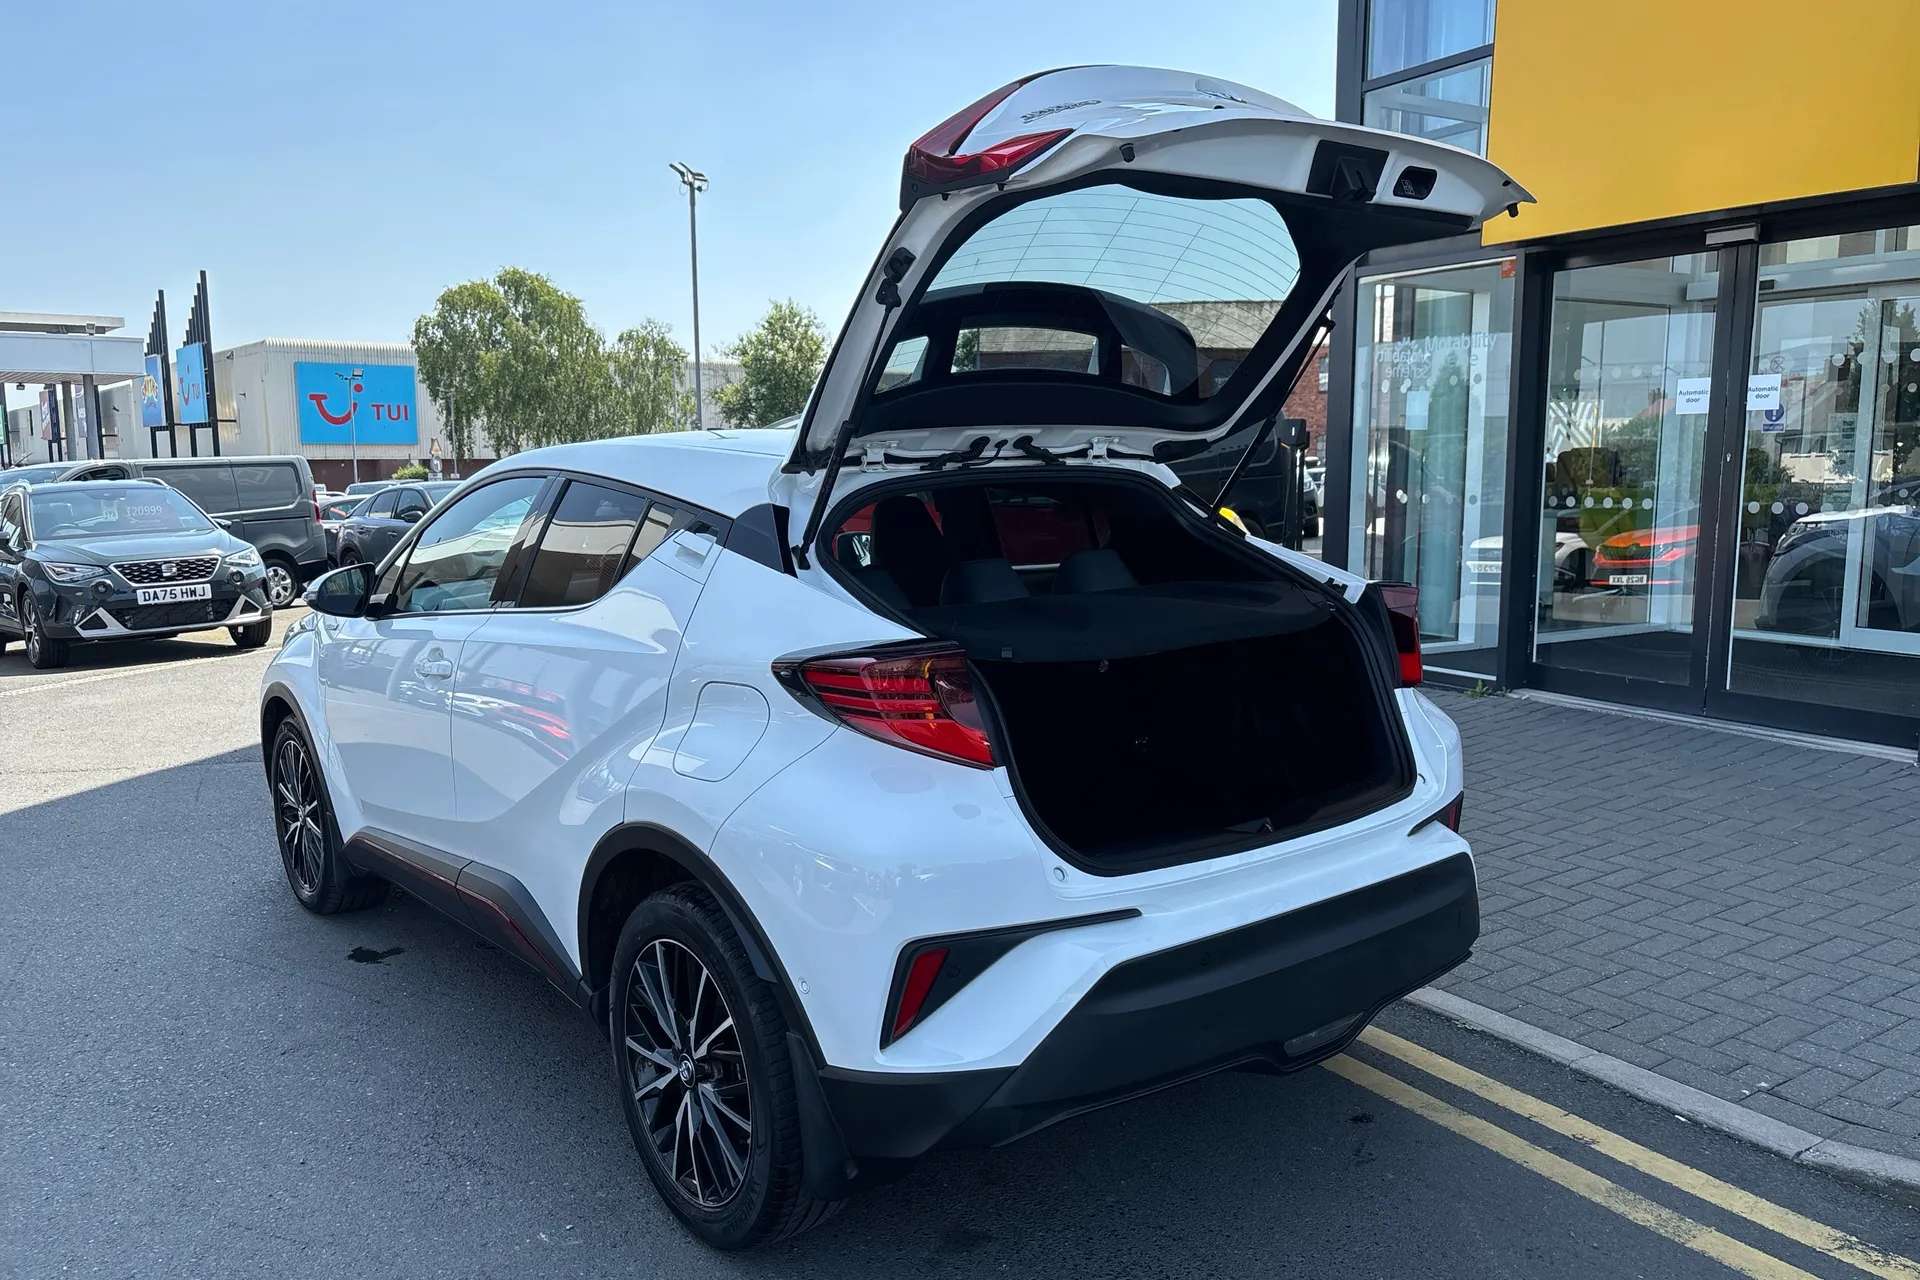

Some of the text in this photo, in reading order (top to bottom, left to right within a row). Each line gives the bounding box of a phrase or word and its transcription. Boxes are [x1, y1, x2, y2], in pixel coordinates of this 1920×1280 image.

[1425, 332, 1498, 352] Motability
[1748, 385, 1778, 393] Automatic
[1755, 391, 1770, 399] door
[371, 404, 409, 421] TUI
[143, 586, 206, 602] DA75 HWJ
